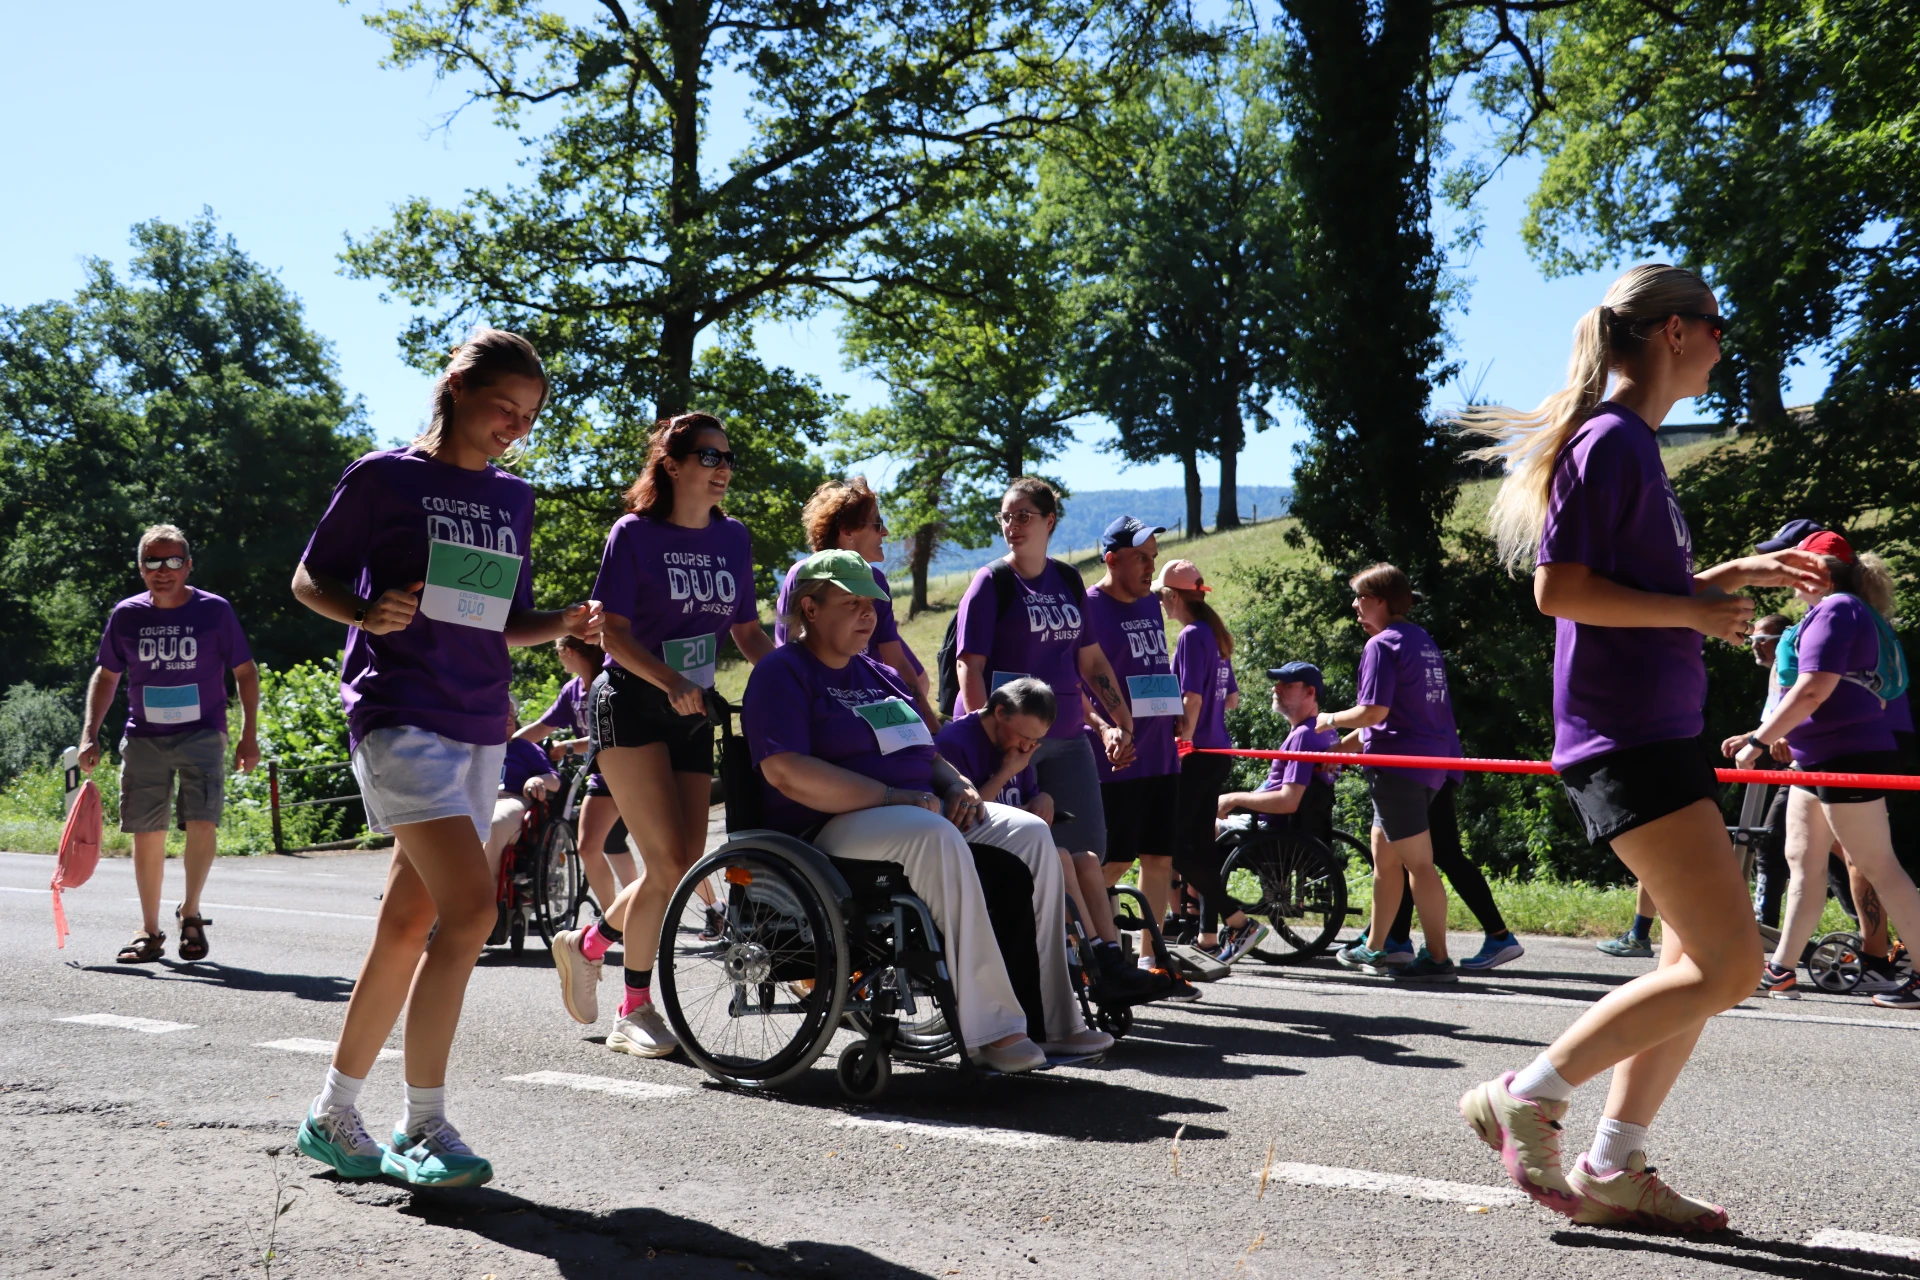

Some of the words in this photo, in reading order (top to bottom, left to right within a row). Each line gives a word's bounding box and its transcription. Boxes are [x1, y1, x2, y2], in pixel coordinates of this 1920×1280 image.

[422, 496, 492, 521] COURSE
[663, 552, 712, 567] COURSE
[458, 552, 503, 589] 20
[667, 568, 736, 603] DUO
[457, 599, 485, 616] DUO
[700, 603, 734, 616] SUISSE
[1027, 603, 1081, 632] DUO
[1121, 619, 1152, 631] COURSE
[140, 626, 180, 636] COURSE
[138, 637, 198, 661] DUO
[683, 639, 706, 668] 20
[166, 661, 197, 670] SUISSE
[875, 706, 907, 724] 20
[897, 728, 917, 739] DUO
